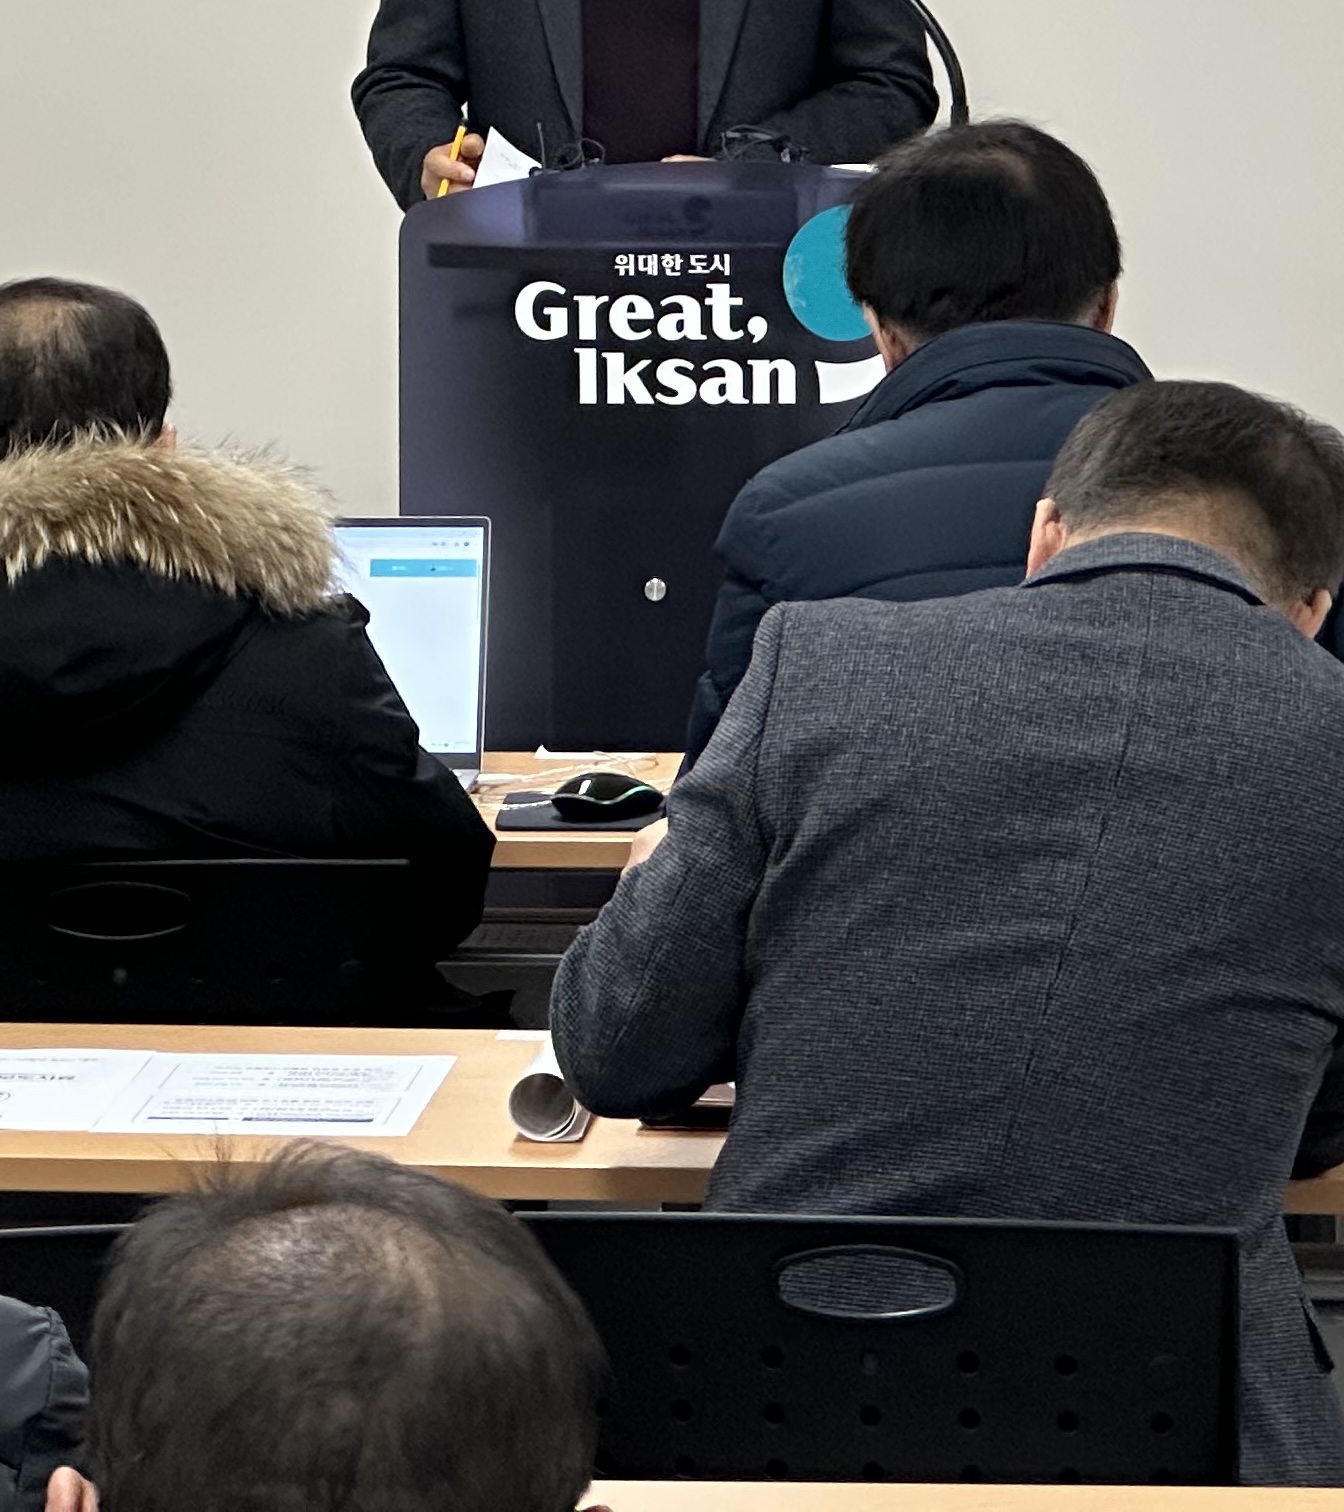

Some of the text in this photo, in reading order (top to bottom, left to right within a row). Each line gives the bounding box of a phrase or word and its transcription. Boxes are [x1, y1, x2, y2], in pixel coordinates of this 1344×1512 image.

[614, 253, 731, 276] 위대한 도시
[514, 280, 769, 344] Great,
[573, 347, 798, 405] Iksan
